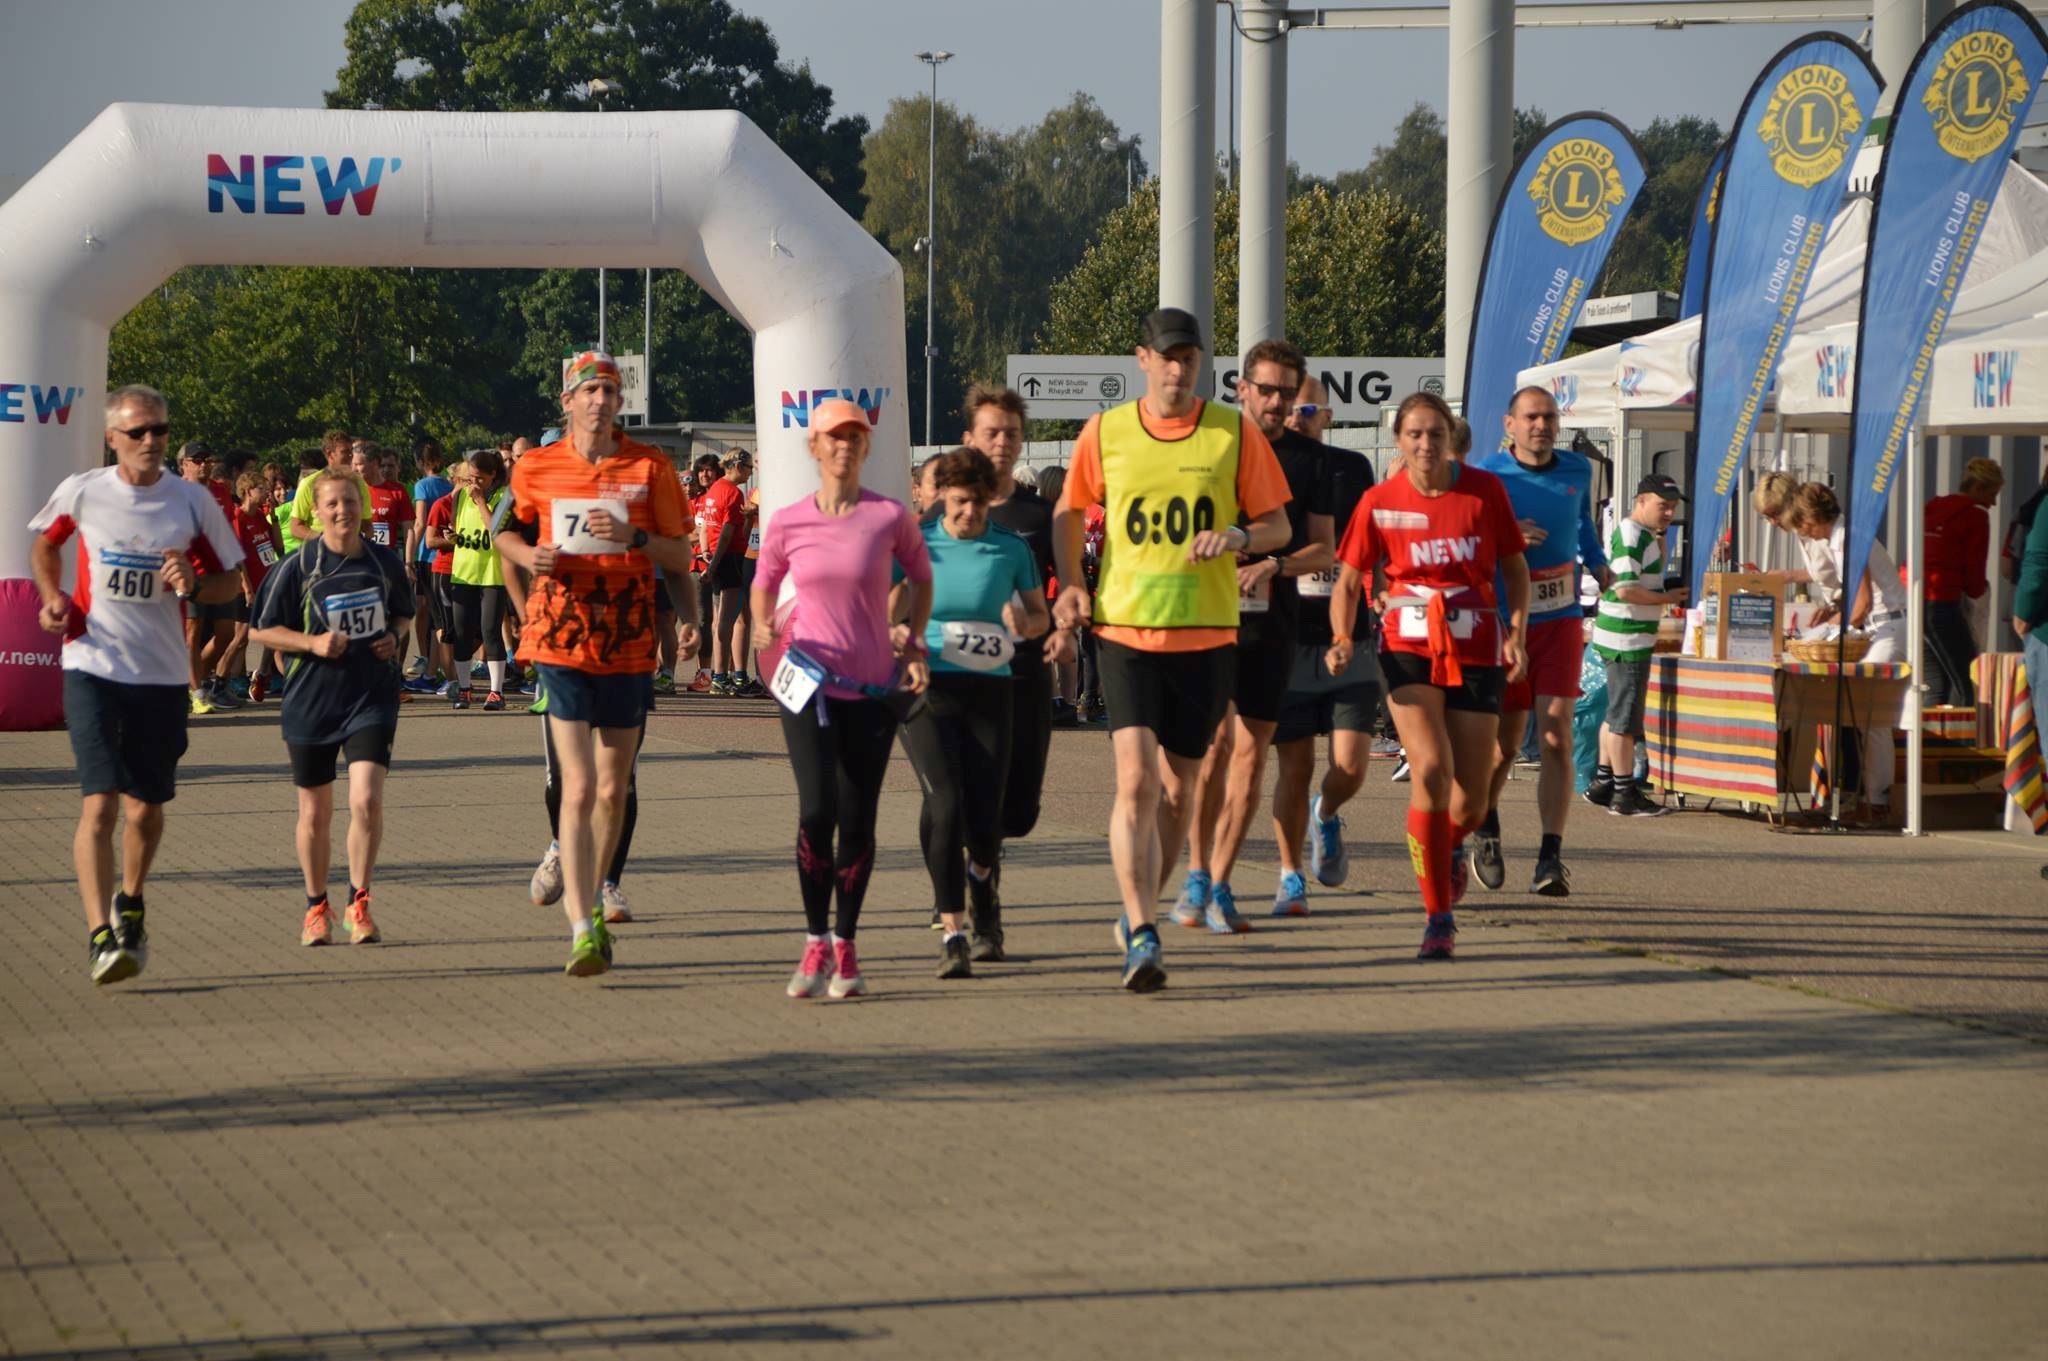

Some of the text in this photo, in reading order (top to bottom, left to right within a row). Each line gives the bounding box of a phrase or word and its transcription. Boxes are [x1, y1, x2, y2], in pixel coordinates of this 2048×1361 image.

[1952, 37, 2009, 62] LIONS
[1784, 68, 1842, 93] LIONS
[1963, 70, 1991, 116] L
[1799, 102, 1825, 145] L
[1553, 141, 1611, 164] LIONS
[1564, 171, 1590, 208] L
[1924, 190, 1971, 287] LIONS CLUB
[1763, 214, 1807, 304] LIONS CLUB
[1527, 267, 1570, 345] LIONS CLUB
[1127, 495, 1215, 546] 6:00
[455, 528, 492, 551] 6:30
[107, 569, 154, 600] 460
[1538, 579, 1565, 601] 381
[339, 604, 376, 636] 457
[956, 633, 1002, 657] 723
